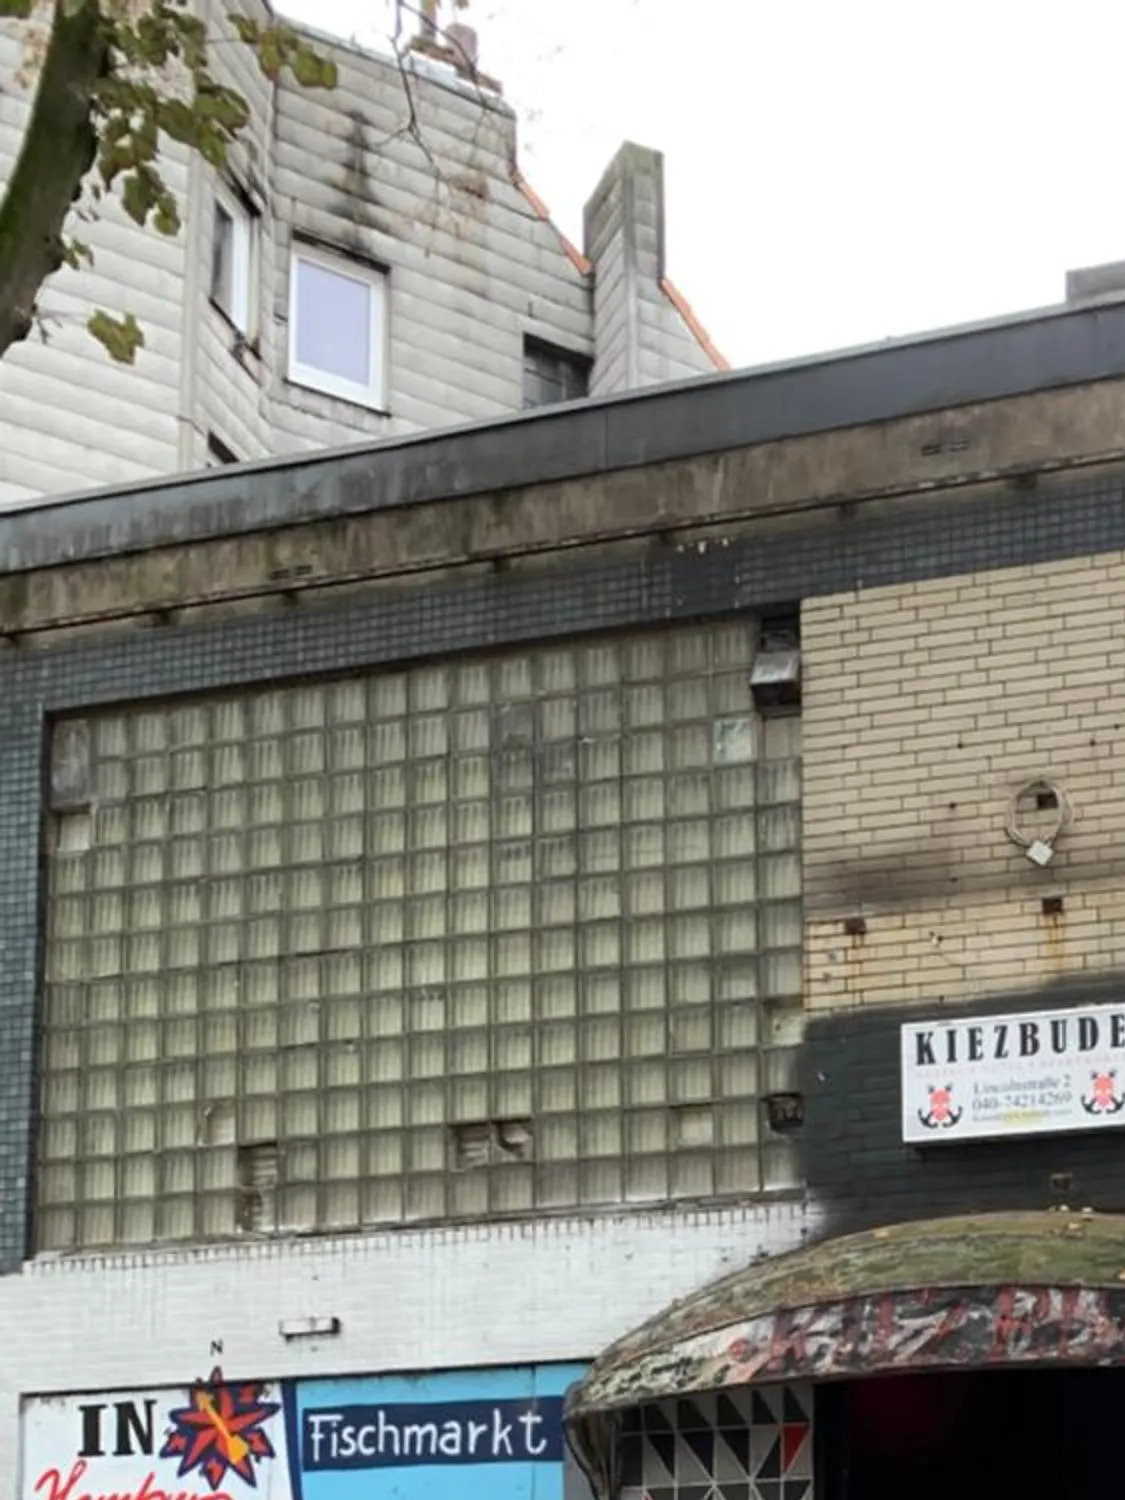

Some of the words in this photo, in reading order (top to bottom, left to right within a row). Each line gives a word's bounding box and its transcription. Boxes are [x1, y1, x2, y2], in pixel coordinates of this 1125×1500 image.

[210, 1338, 223, 1357] N
[77, 1398, 158, 1457] IN
[307, 1407, 547, 1463] Fischmarkt
